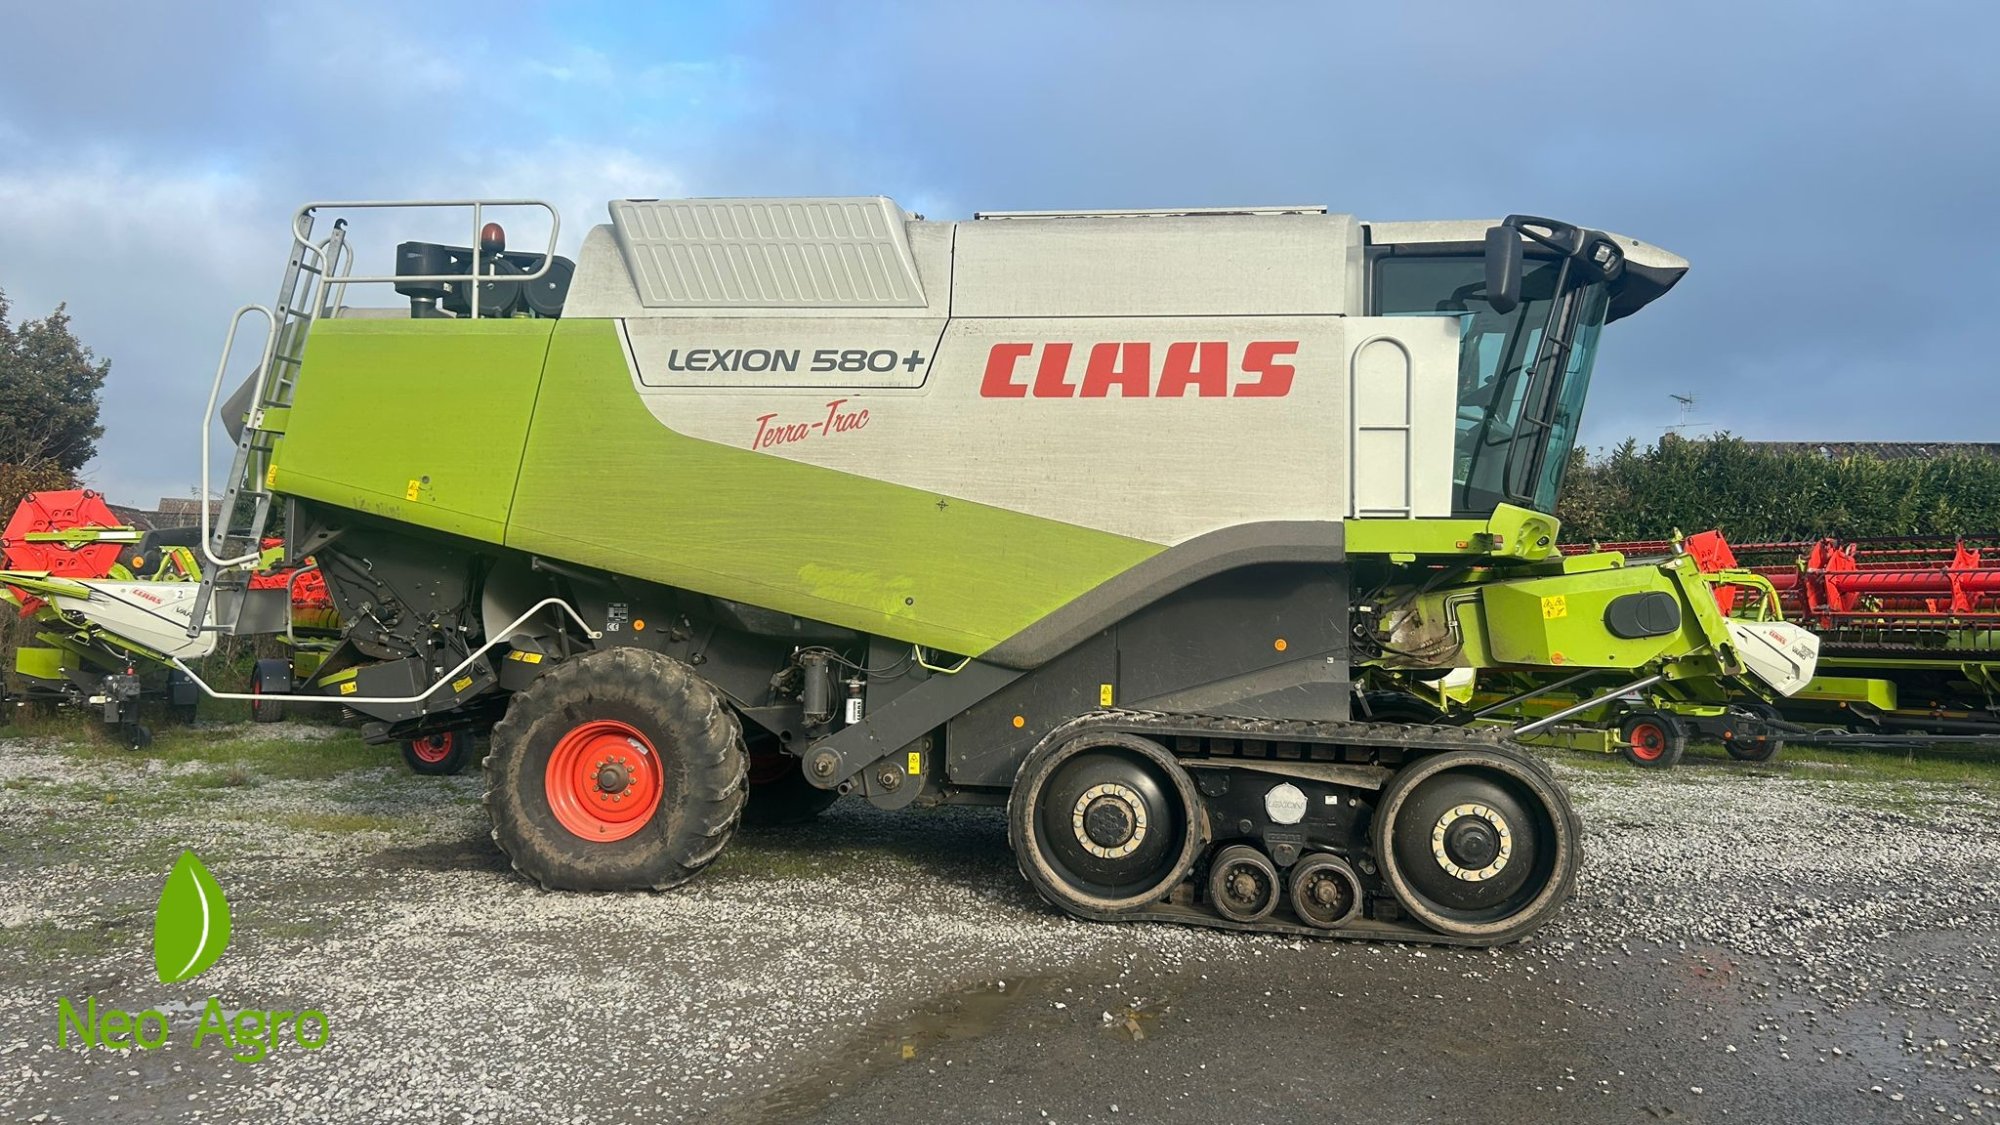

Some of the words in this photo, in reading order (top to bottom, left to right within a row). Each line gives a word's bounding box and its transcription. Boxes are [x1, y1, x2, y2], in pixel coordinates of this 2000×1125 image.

[668, 350, 800, 372] LEXION
[810, 350, 925, 373] 580+
[980, 341, 1300, 398] CLAAS
[753, 399, 869, 450] Terra-Trac
[132, 589, 162, 604] CLAAS
[177, 590, 183, 599] 2
[1268, 799, 1304, 810] LEXION
